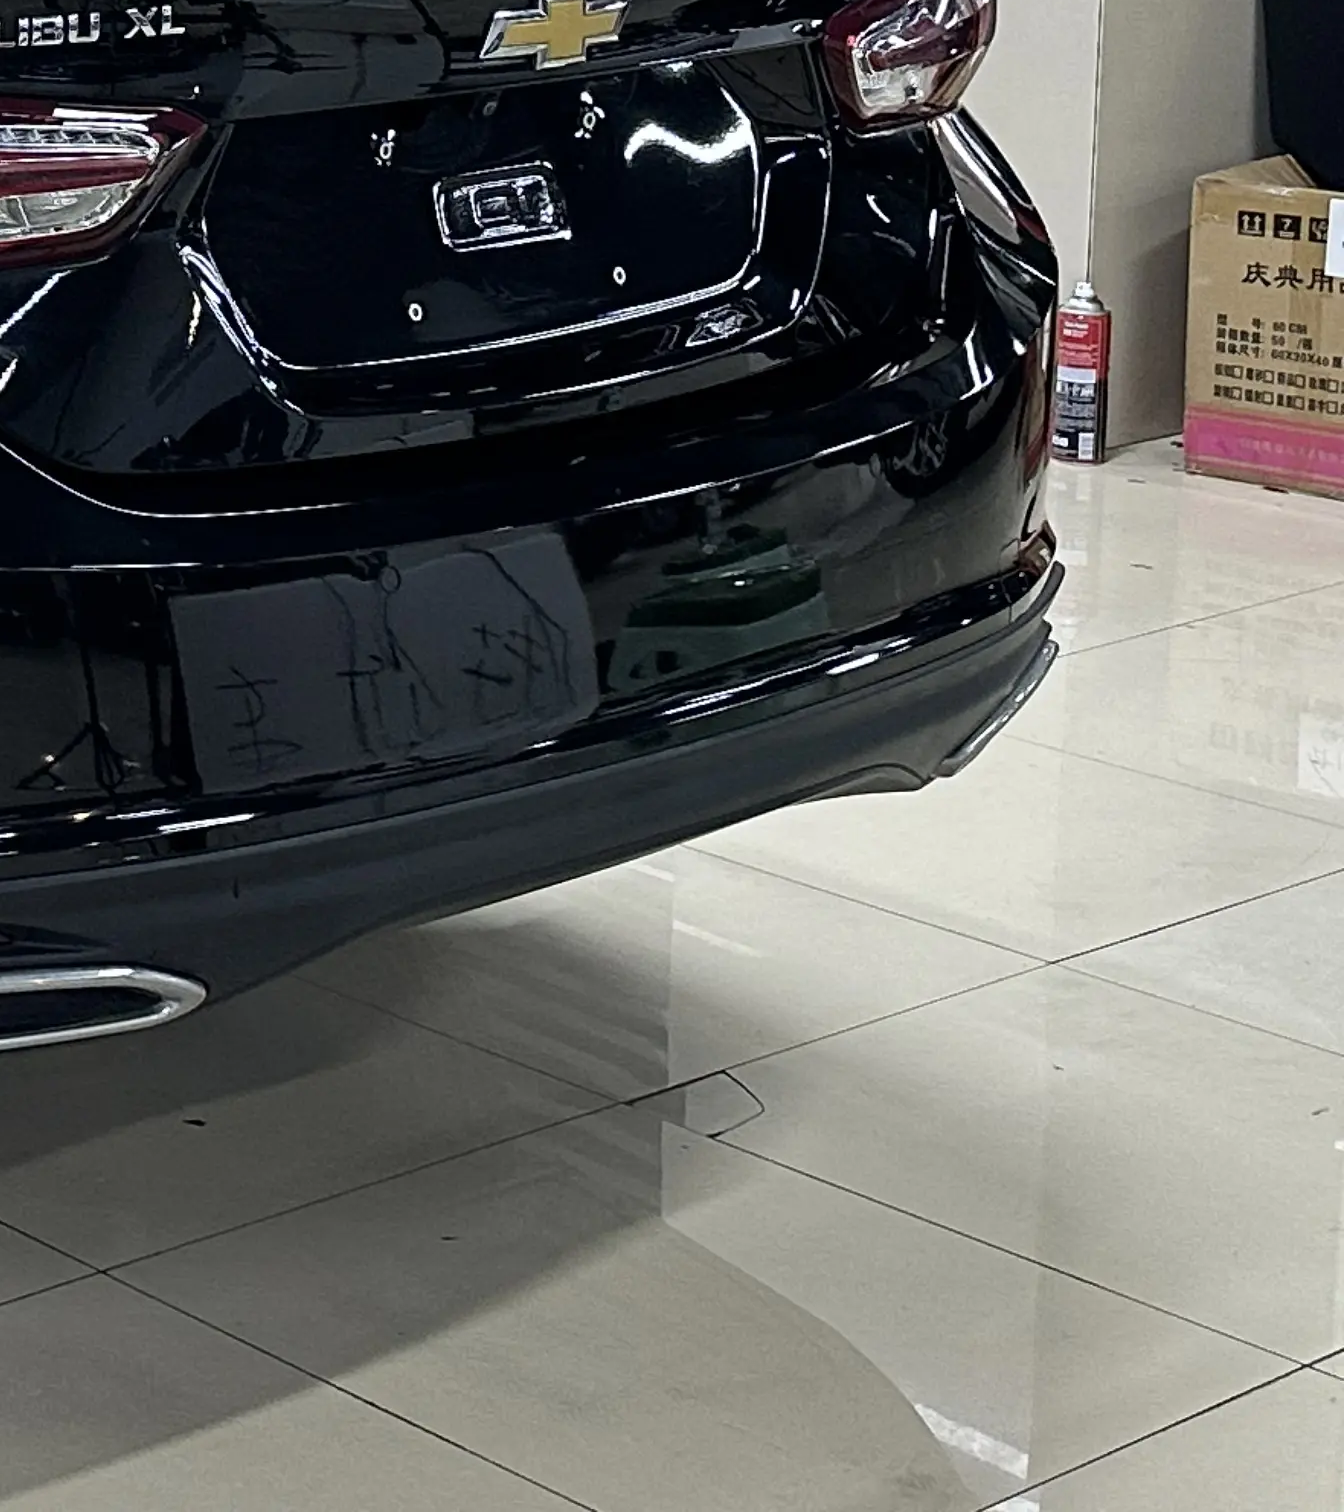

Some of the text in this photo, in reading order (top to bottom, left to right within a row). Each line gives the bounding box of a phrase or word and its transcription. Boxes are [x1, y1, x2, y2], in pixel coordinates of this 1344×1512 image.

[124, 4, 186, 39] XL
[1241, 261, 1344, 295] 庆典用
